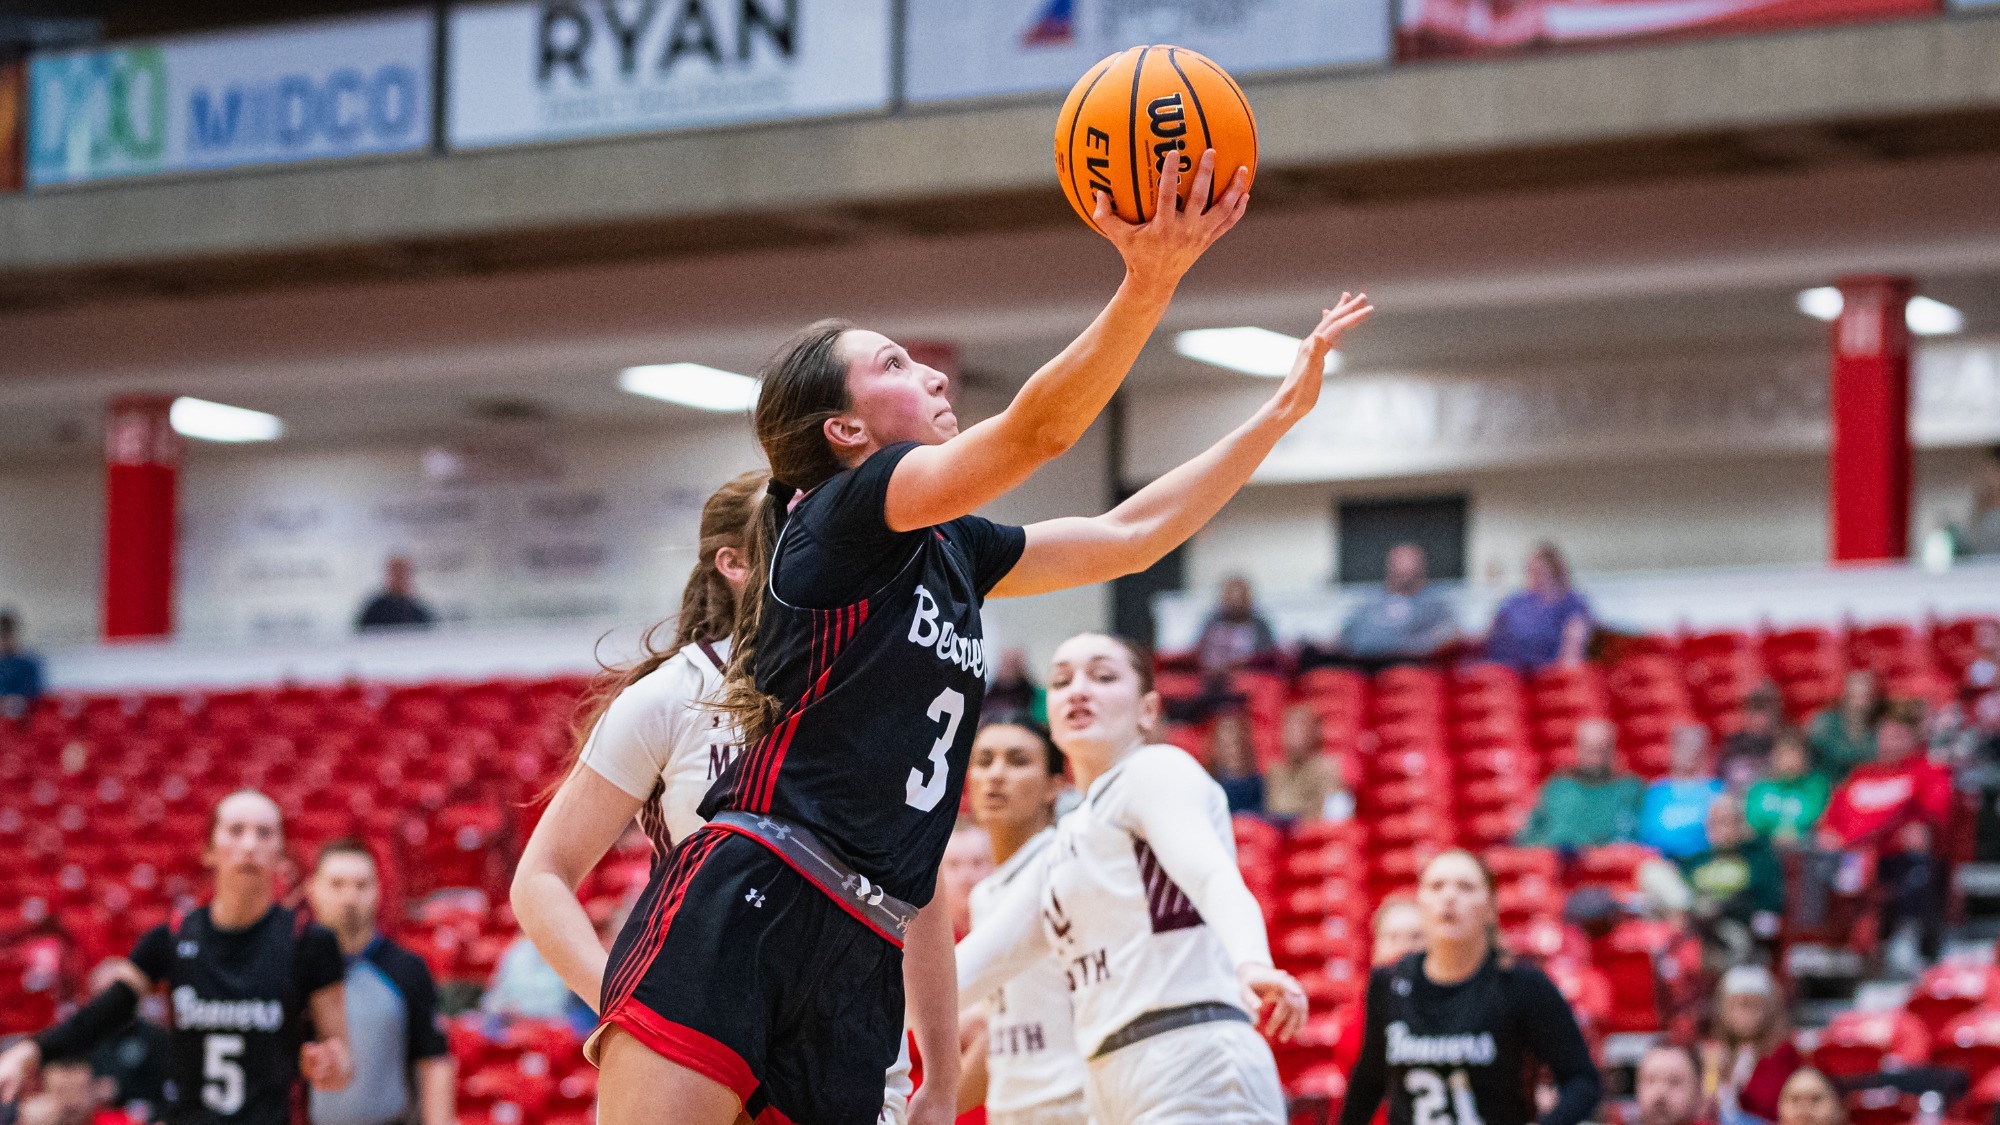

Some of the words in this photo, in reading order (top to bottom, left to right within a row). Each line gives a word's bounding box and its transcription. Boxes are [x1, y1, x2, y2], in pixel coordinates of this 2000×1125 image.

[538, 0, 799, 86] RYAN
[1146, 92, 1192, 213] Wil
[907, 584, 988, 682] Beave
[905, 687, 965, 812] 3
[202, 1033, 247, 1116] 5
[1403, 1067, 1486, 1125] 21
